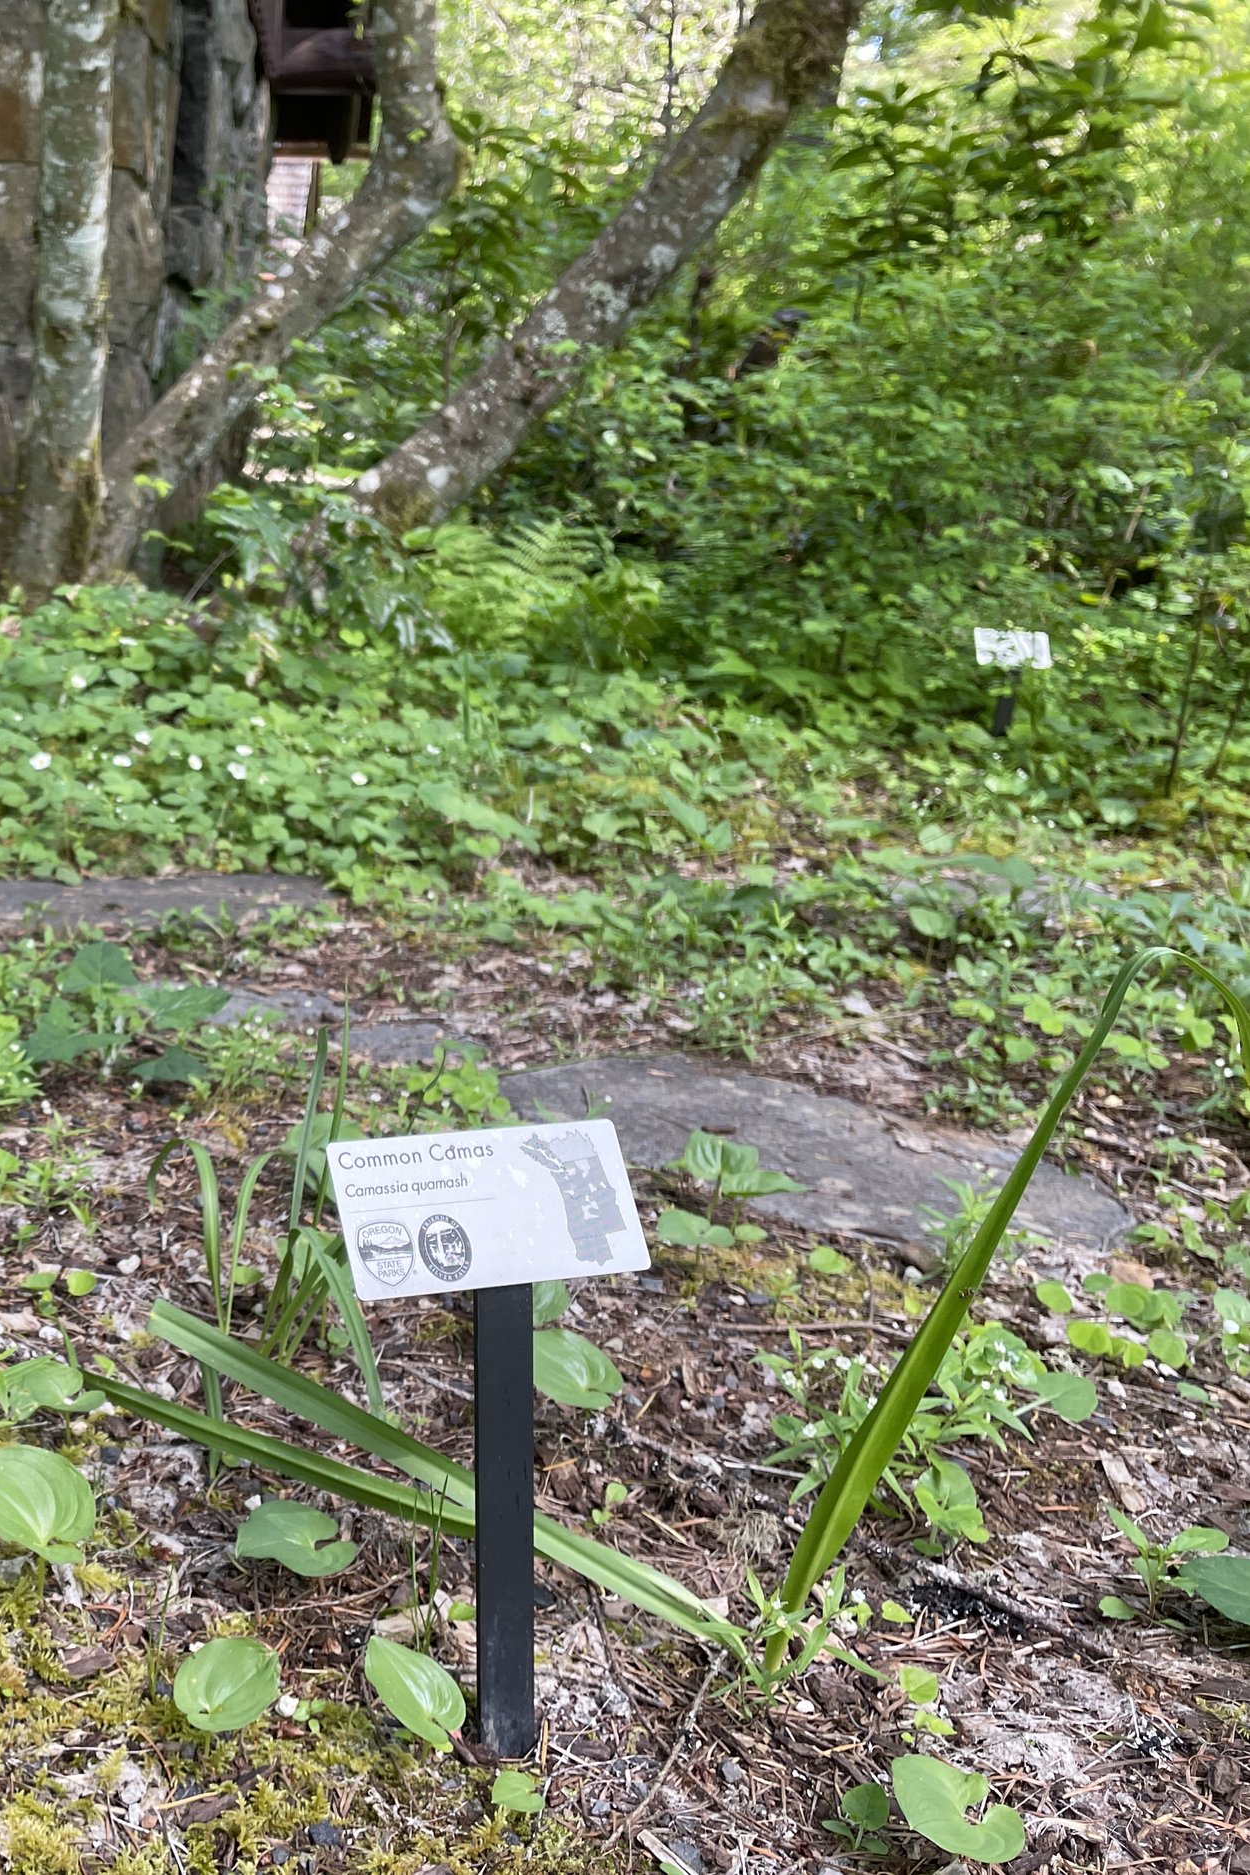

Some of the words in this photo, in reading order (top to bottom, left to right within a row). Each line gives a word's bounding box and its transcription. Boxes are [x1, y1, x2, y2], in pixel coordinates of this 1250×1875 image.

[338, 1150, 422, 1170] Common
[429, 1143, 494, 1162] Camas
[345, 1180, 409, 1198] Camassia
[411, 1173, 468, 1195] quamash
[362, 1225, 402, 1239] OREGON
[376, 1260, 402, 1269] STATE
[377, 1268, 406, 1278] PARKS
